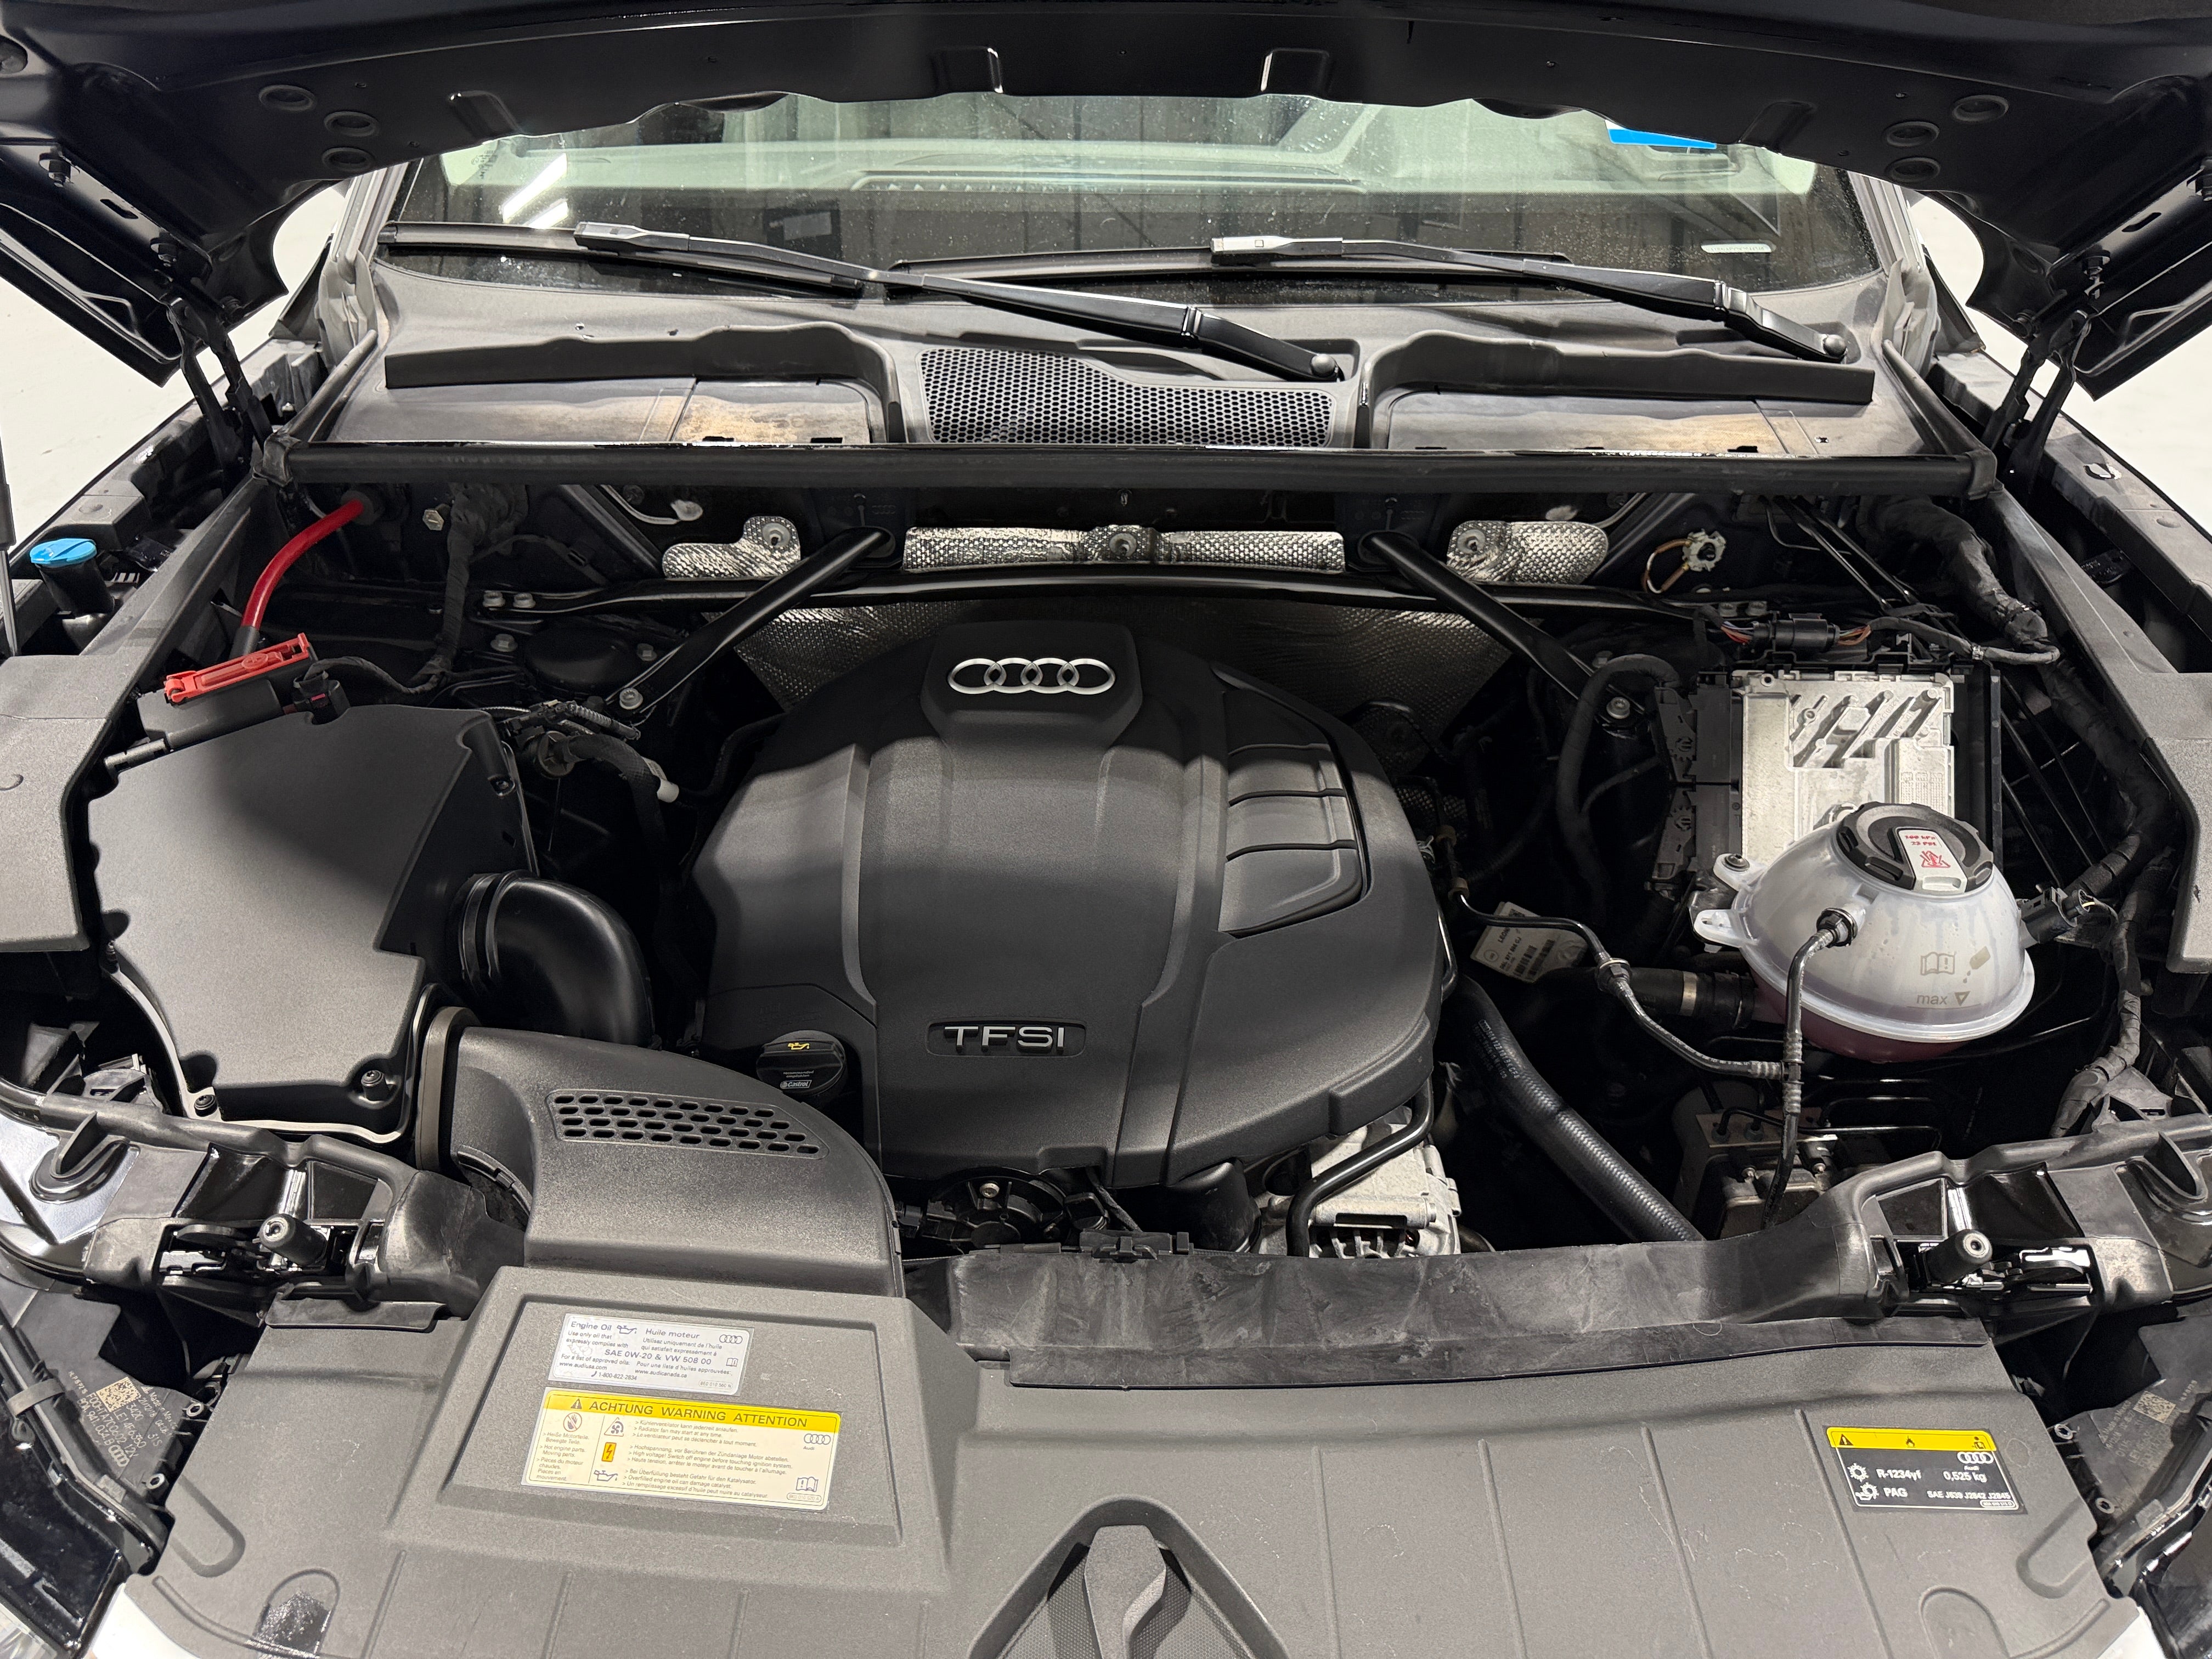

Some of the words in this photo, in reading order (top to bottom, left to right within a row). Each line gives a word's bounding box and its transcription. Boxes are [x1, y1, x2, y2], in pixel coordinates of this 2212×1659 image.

[1916, 995, 1948, 1005] max
[944, 1026, 1064, 1052] TFSI
[571, 1321, 598, 1330] Engine
[624, 1351, 652, 1359] 0W-20
[559, 1362, 607, 1370] www.audiusa.com
[599, 1372, 637, 1381] 1-800-822-2834
[635, 1369, 687, 1378] www.audicanada.ca
[589, 1401, 653, 1415] ACHTUNG
[661, 1406, 726, 1421] WARNING
[733, 1413, 808, 1427] ATTENTION
[717, 1451, 747, 1459] Zündanlage
[729, 1458, 752, 1466] touching
[639, 1468, 669, 1477] Überfüllung
[1876, 1469, 1922, 1481] R-1234yf
[1943, 1471, 1972, 1481] 0,525
[1973, 1471, 1987, 1482] kg
[635, 1482, 667, 1491] remplissage
[689, 1480, 710, 1488] damage
[1883, 1487, 1908, 1497] PAG
[1927, 1490, 1944, 1498] SAE
